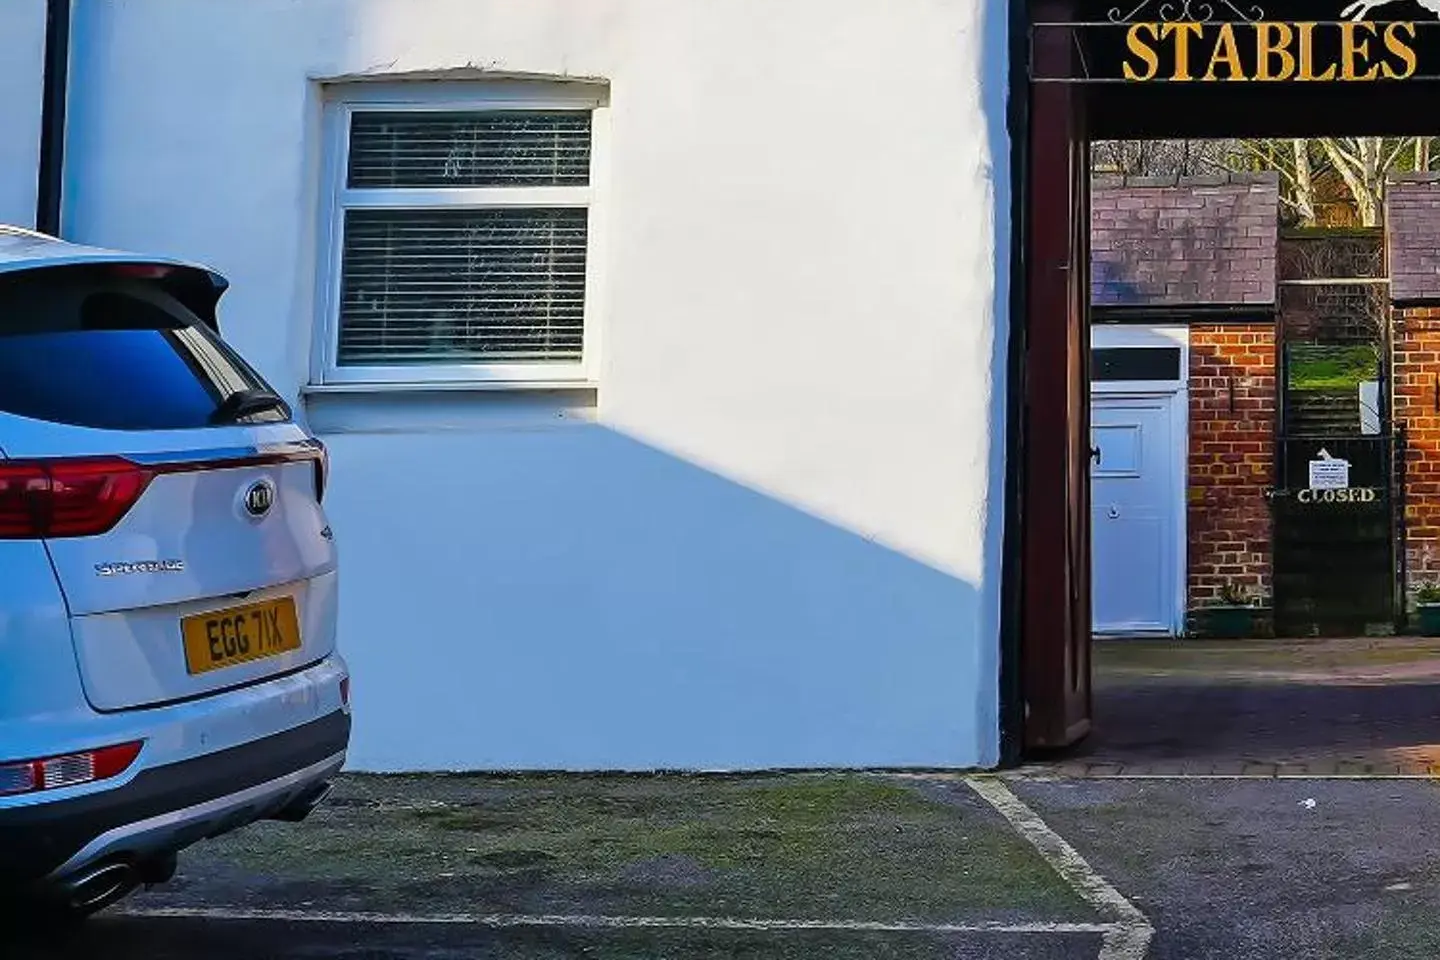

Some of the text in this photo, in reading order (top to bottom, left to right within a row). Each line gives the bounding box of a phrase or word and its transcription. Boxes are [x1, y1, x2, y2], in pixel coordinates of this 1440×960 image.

[1121, 20, 1418, 82] STABLES
[1297, 488, 1376, 503] CLOSED
[205, 605, 283, 662] EGG 71X
